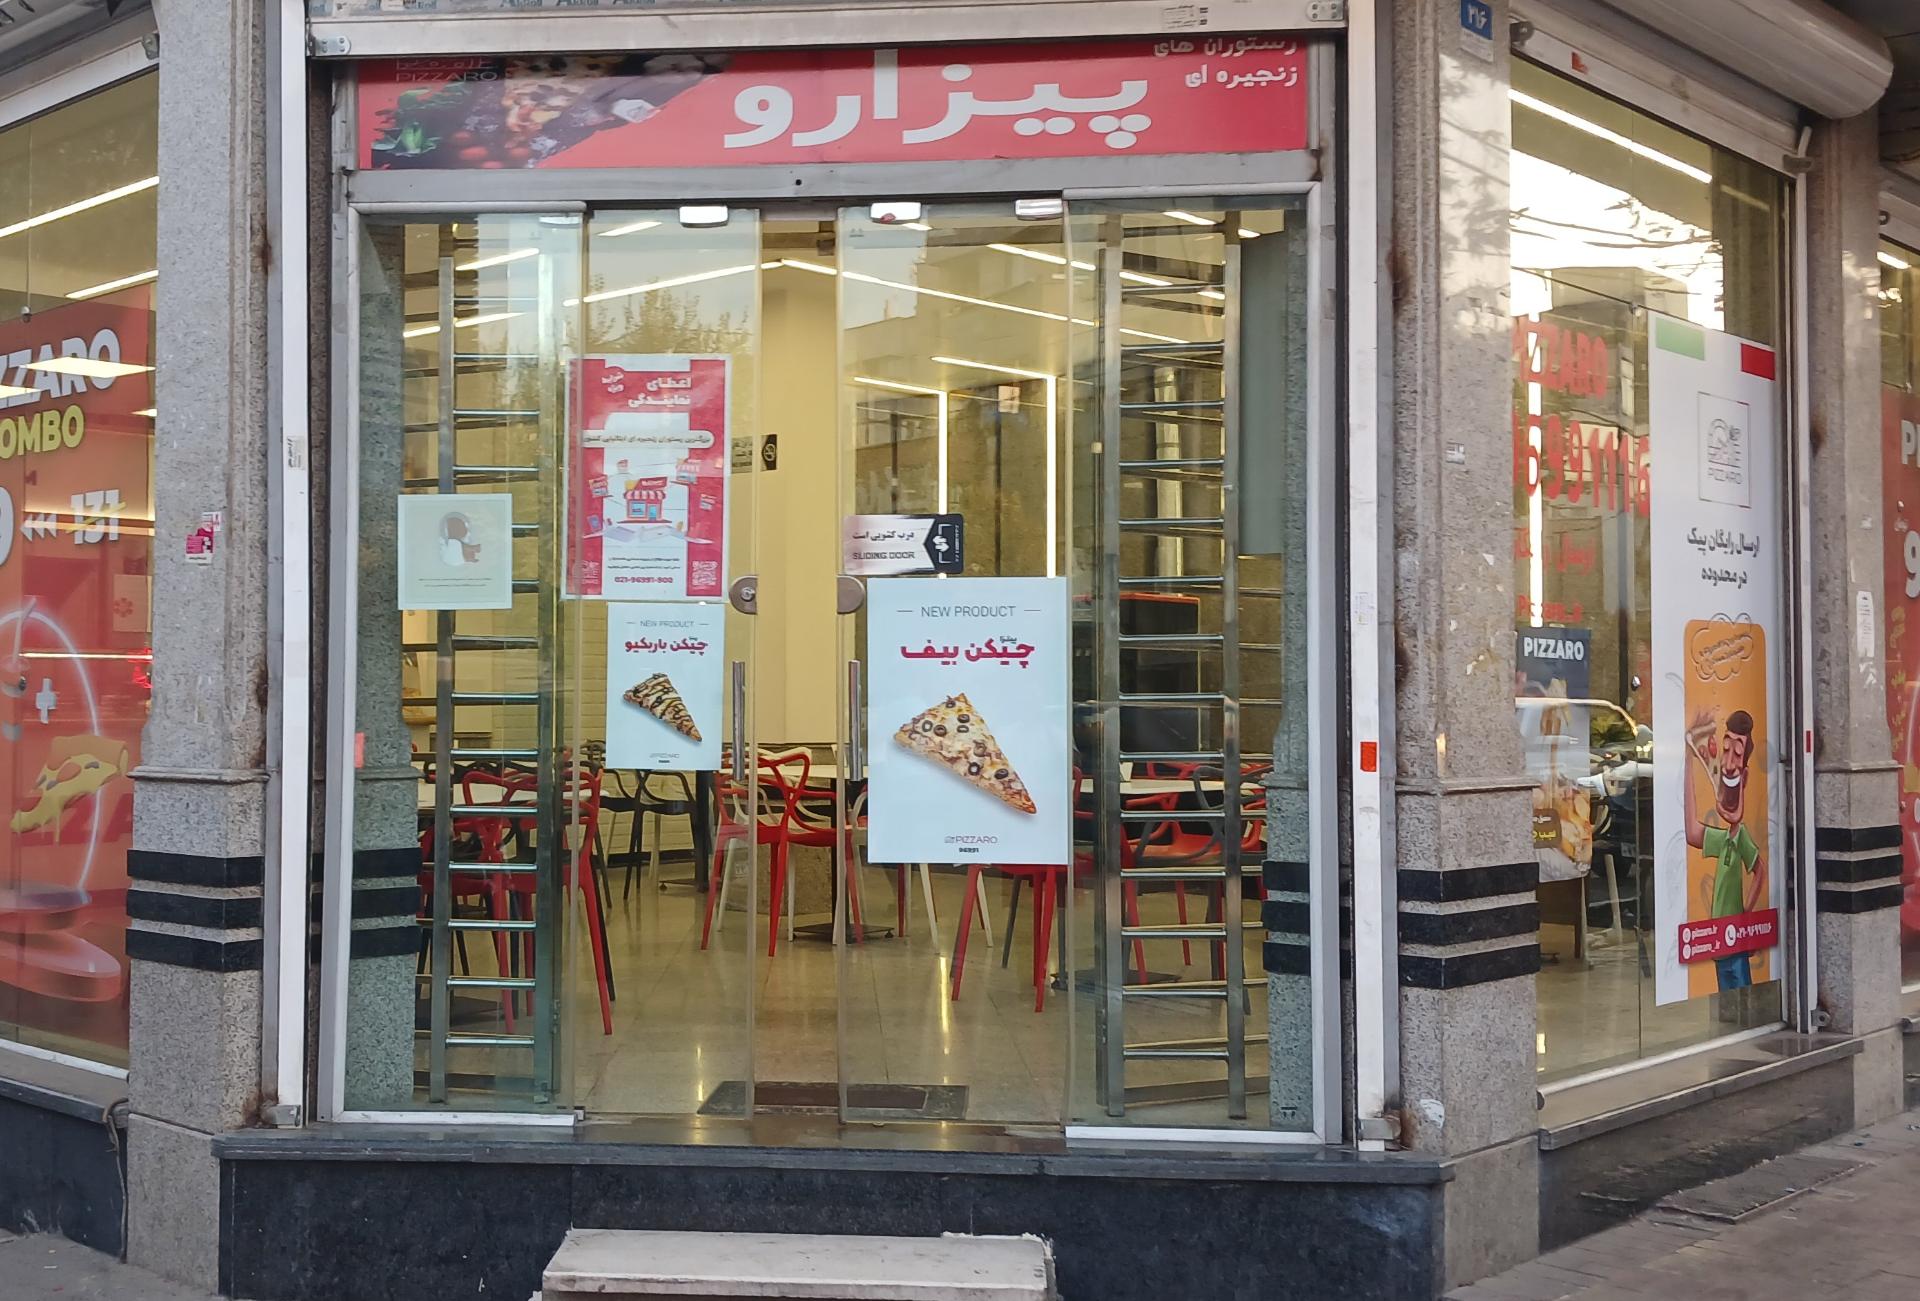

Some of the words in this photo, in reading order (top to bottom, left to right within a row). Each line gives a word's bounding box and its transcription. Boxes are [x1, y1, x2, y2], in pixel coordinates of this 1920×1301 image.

[1153, 39, 1195, 58] های
[1204, 36, 1298, 58] رستوران
[395, 71, 498, 83] PIZZARO
[1184, 63, 1208, 88] ای
[1215, 65, 1298, 89] زنجیره
[723, 48, 1152, 149] پیزارو
[0, 328, 121, 409] ZARO
[646, 375, 692, 391] اعطای
[627, 392, 692, 408] نمایندگی
[70, 488, 121, 546] 131
[852, 530, 870, 540] است
[869, 530, 897, 542] کشویی
[897, 531, 915, 541] درب
[1686, 526, 1708, 556] پیک
[1708, 527, 1735, 556] رایگان
[1735, 532, 1761, 558] ارسال
[852, 551, 888, 560] SLIDING
[888, 551, 916, 560] DOOR
[1701, 567, 1738, 588] محدوده
[1737, 570, 1748, 590] در
[921, 606, 951, 618] NEW
[954, 605, 1017, 618] PRODUCT
[640, 619, 657, 628] NEW
[659, 620, 695, 629] PRODUCT
[669, 638, 709, 656] چیکن
[900, 639, 960, 666] بیف
[964, 637, 1036, 669] چیکن
[1523, 637, 1585, 662] PIZZARO
[955, 835, 998, 845] PIZZARO
